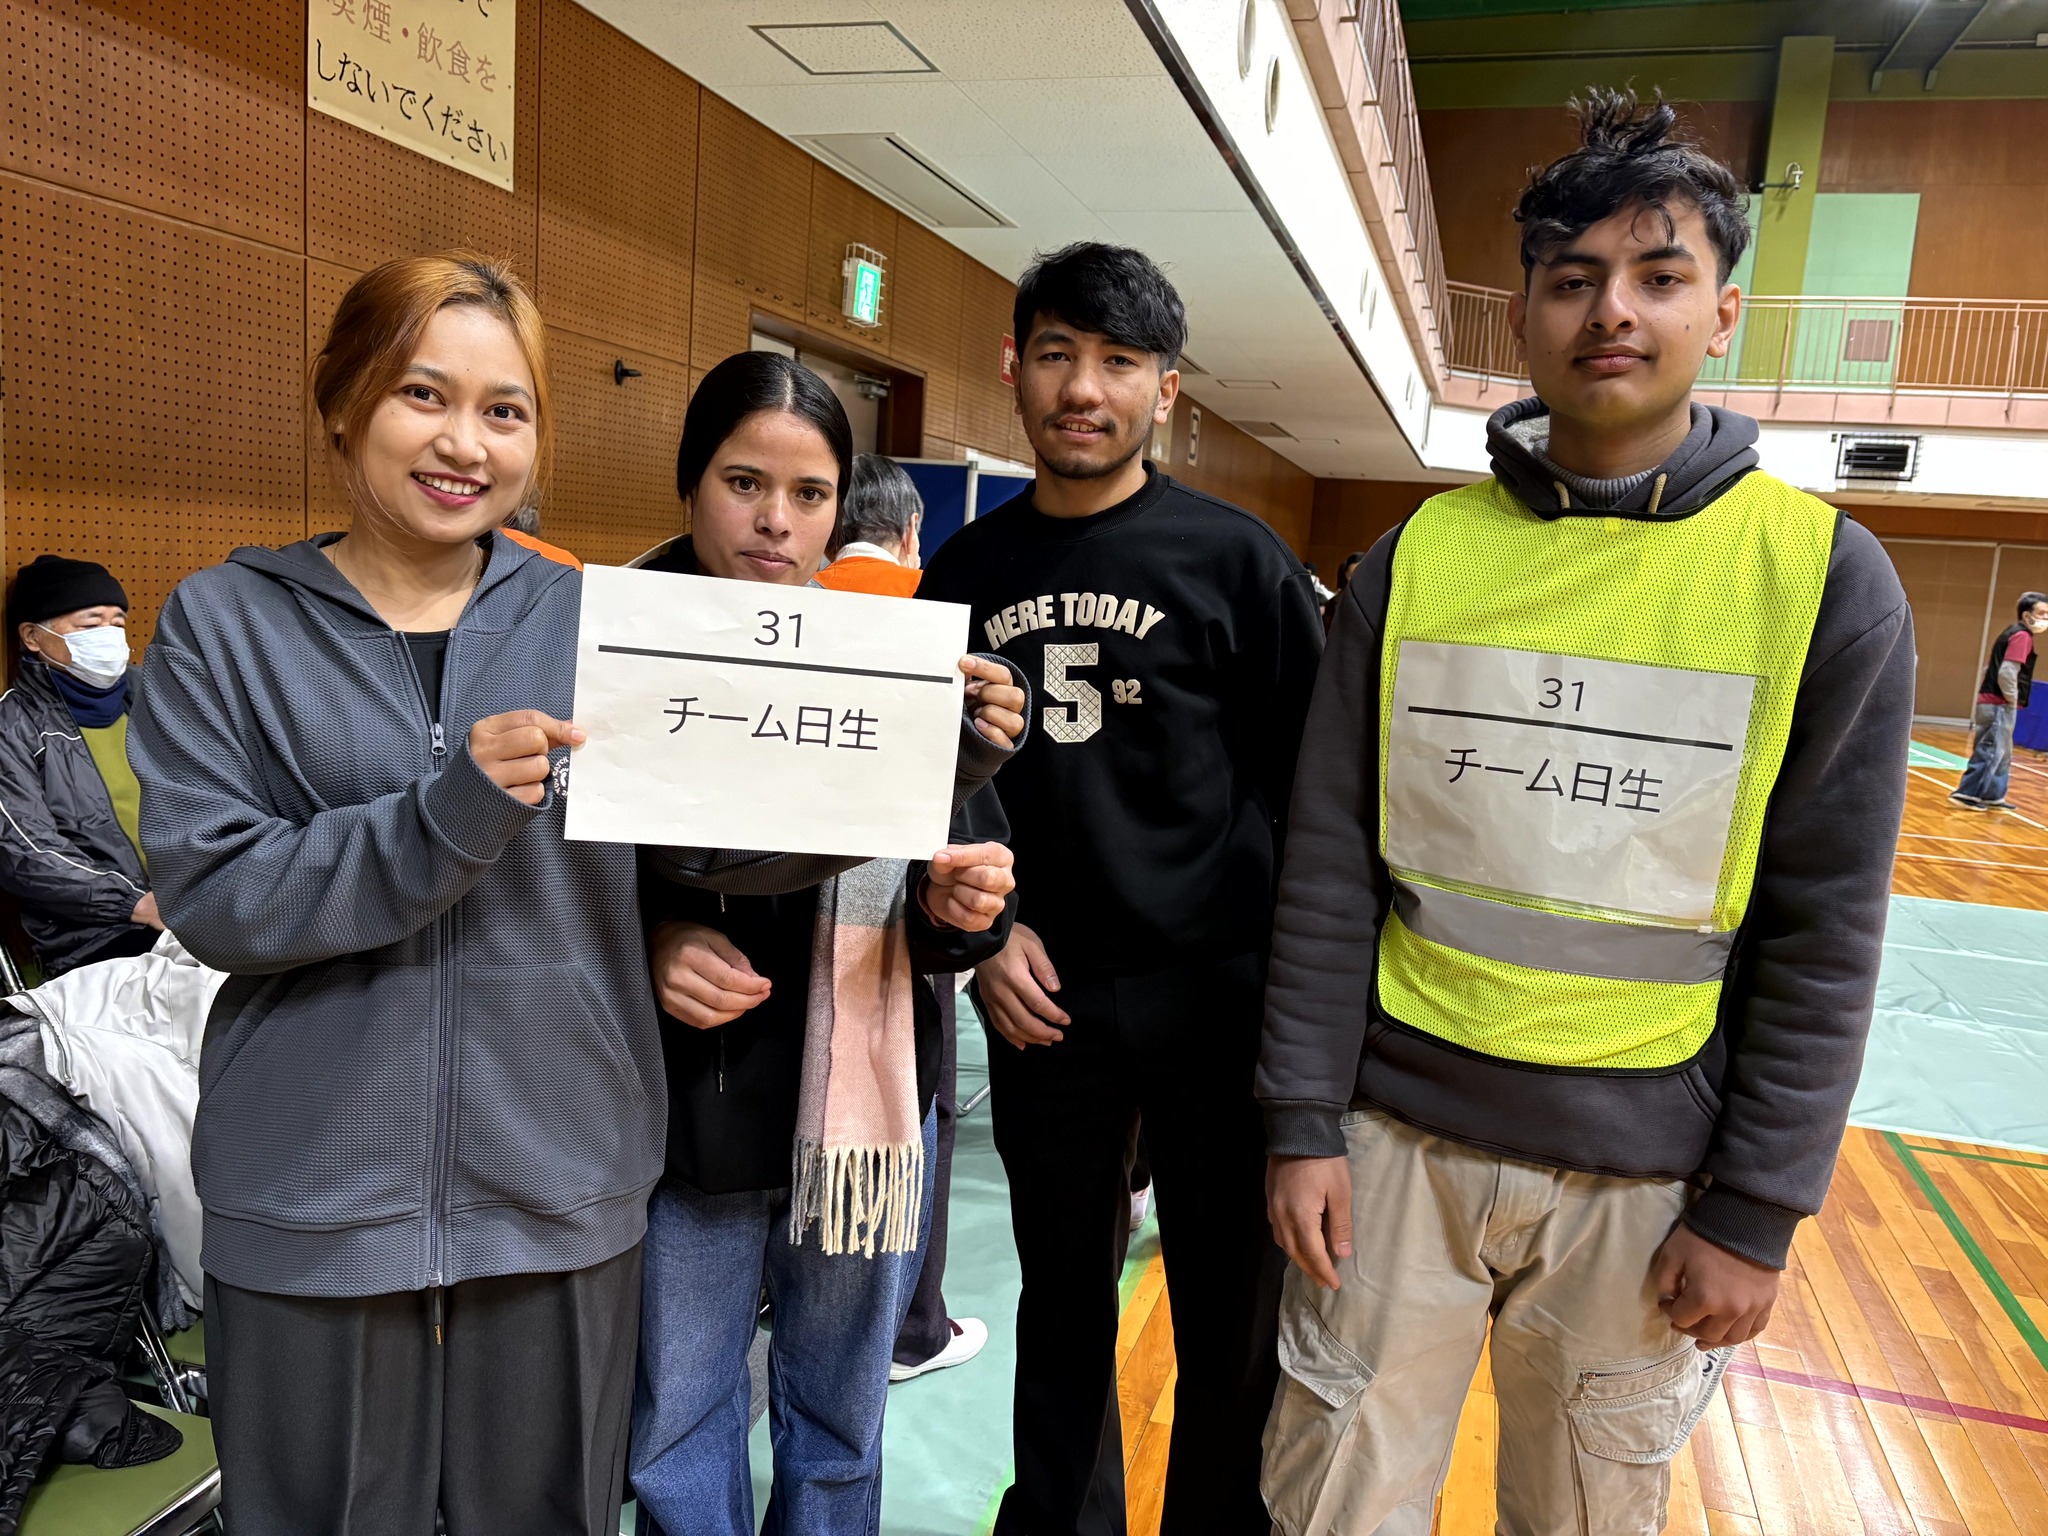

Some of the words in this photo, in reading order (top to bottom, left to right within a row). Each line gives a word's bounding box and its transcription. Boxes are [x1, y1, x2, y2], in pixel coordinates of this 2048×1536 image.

[316, 38, 508, 162] しないでください
[754, 610, 803, 648] 31
[983, 595, 1056, 651] HERE
[1060, 592, 1166, 640] TODAY
[1043, 642, 1102, 743] 5
[1111, 678, 1143, 705] 92
[1538, 677, 1586, 712] 31
[663, 697, 879, 751] チーム日生
[1444, 748, 1663, 813] チーム日生
